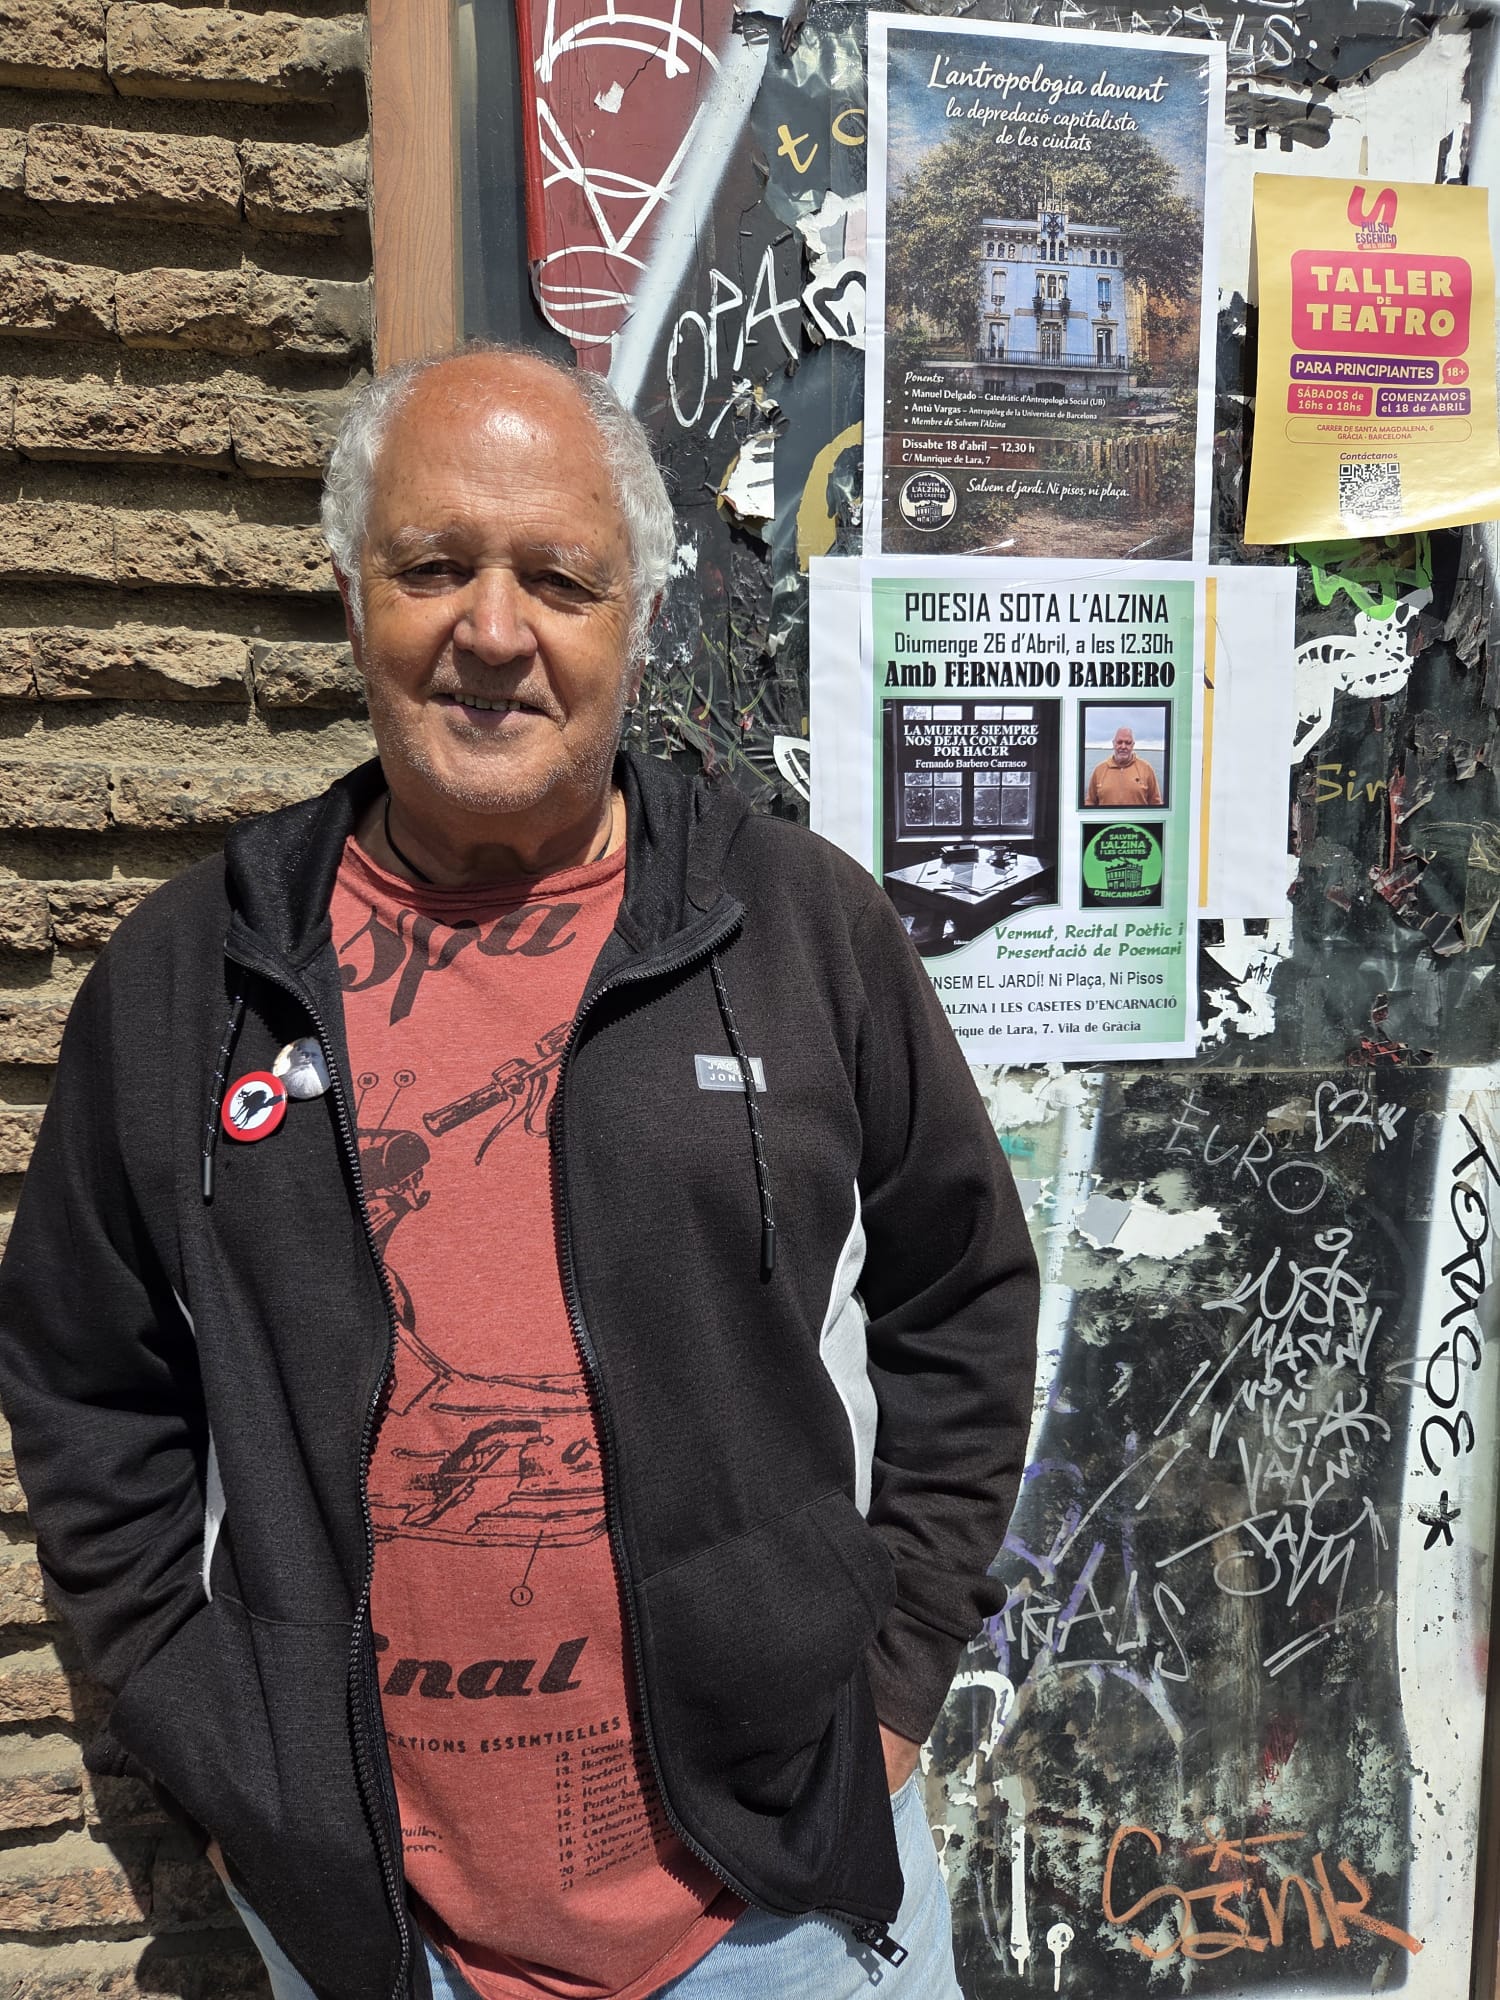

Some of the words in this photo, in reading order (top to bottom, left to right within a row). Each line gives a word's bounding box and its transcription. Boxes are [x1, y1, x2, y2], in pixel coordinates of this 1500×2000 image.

[927, 55, 1086, 104] L'antropologia
[1091, 71, 1169, 103] davant
[945, 97, 964, 118] la
[967, 101, 1050, 126] depredació
[1053, 108, 1139, 135] capitalista
[996, 125, 1015, 146] de
[1018, 128, 1039, 148] les
[1042, 132, 1092, 151] ciutats
[1361, 222, 1389, 233] PULSO
[1310, 266, 1454, 298] TALLER
[1376, 296, 1392, 305] DE
[1306, 303, 1456, 337] TEATRO
[904, 371, 944, 384] Ponents:
[1296, 361, 1332, 375] PARA
[1335, 362, 1434, 379] PRINCIPIANTES
[1446, 367, 1466, 377] 18+
[912, 389, 942, 399] Manuel
[944, 390, 977, 401] Delgado
[1070, 397, 1089, 405] Social
[1090, 398, 1106, 407] (UB)
[1297, 385, 1349, 400] SÁBADOS
[1352, 391, 1364, 401] de
[1381, 392, 1467, 402] COMENZAMOS
[934, 404, 961, 415] Vargas
[1005, 408, 1014, 416] de
[1022, 410, 1056, 418] Universitat
[1066, 411, 1097, 419] Barcelona
[1298, 400, 1323, 410] 16hs
[1337, 402, 1361, 412] 18hs
[1381, 403, 1391, 413] el
[1395, 404, 1409, 413] 18
[1412, 404, 1427, 413] de
[1430, 402, 1466, 412] ABRIL
[911, 417, 942, 426] Membre
[944, 418, 953, 427] de
[954, 418, 979, 427] Salvem
[1316, 424, 1342, 432] CARRER
[902, 438, 944, 450] Dissabte
[946, 440, 957, 450] 18
[960, 440, 988, 451] d'abril
[1029, 443, 1035, 453] h
[902, 453, 912, 462] C/
[914, 453, 953, 464] Manrique
[954, 455, 962, 463] de
[985, 456, 991, 464] 7
[1340, 452, 1398, 461] Contáctanos
[966, 477, 1003, 493] Salvem
[1006, 480, 1016, 493] el
[1046, 481, 1060, 495] Ni
[1060, 483, 1087, 501] pisos,
[1088, 485, 1100, 497] ni
[1100, 483, 1130, 502] plaça.
[904, 592, 990, 624] POESIA
[999, 592, 1059, 623] SOTA
[1069, 593, 1169, 624] L'ALZINA
[895, 632, 978, 659] Diumenge
[983, 633, 1006, 654] 26
[1011, 632, 1070, 657] d'Abril,
[1076, 638, 1085, 654] a
[1091, 633, 1115, 654] les
[1120, 633, 1173, 655] 12.30h
[884, 661, 937, 688] Amb
[944, 661, 1060, 688] FERNANDO
[1068, 661, 1175, 688] BARBERO
[904, 725, 921, 735] LA
[923, 725, 978, 736] MUERTE
[981, 725, 1039, 736] SIEMPRE
[905, 735, 932, 746] NOS
[934, 735, 967, 746] DEJA
[969, 735, 998, 746] CON
[1000, 735, 1037, 746] ALGO
[933, 746, 961, 757] POR
[963, 746, 1009, 757] HACER
[915, 759, 954, 769] Fernando
[956, 759, 989, 769] Barbero
[990, 759, 1027, 768] Carrasco
[1101, 841, 1145, 849] L'ALZINA
[994, 925, 1058, 941] Vermut,
[1065, 924, 1118, 939] Recital
[1178, 922, 1184, 936] i
[997, 943, 1087, 960] Presentació
[1093, 943, 1111, 957] de
[1118, 941, 1182, 957] Poemari
[339, 902, 583, 1026] spa
[929, 975, 974, 990] NSEM
[978, 975, 994, 989] EL
[998, 971, 1044, 988] JARDÍ!
[1049, 973, 1062, 986] Ni
[1067, 972, 1105, 989] Plaça,
[1110, 971, 1122, 985] Ni
[1127, 971, 1164, 984] Pisos
[943, 1002, 987, 1015] ALZINA
[1000, 1001, 1023, 1013] LES
[1028, 1000, 1081, 1012] CASETES
[1086, 995, 1177, 1011] D'ENCARNACIÓ
[988, 1025, 1002, 1035] de
[1007, 1024, 1037, 1036] Lara,
[1042, 1024, 1054, 1034] 7.
[1058, 1021, 1080, 1033] Vila
[1085, 1022, 1098, 1033] de
[709, 1073, 744, 1082] JONE
[480, 1716, 621, 1753] ESSENTIELLES
